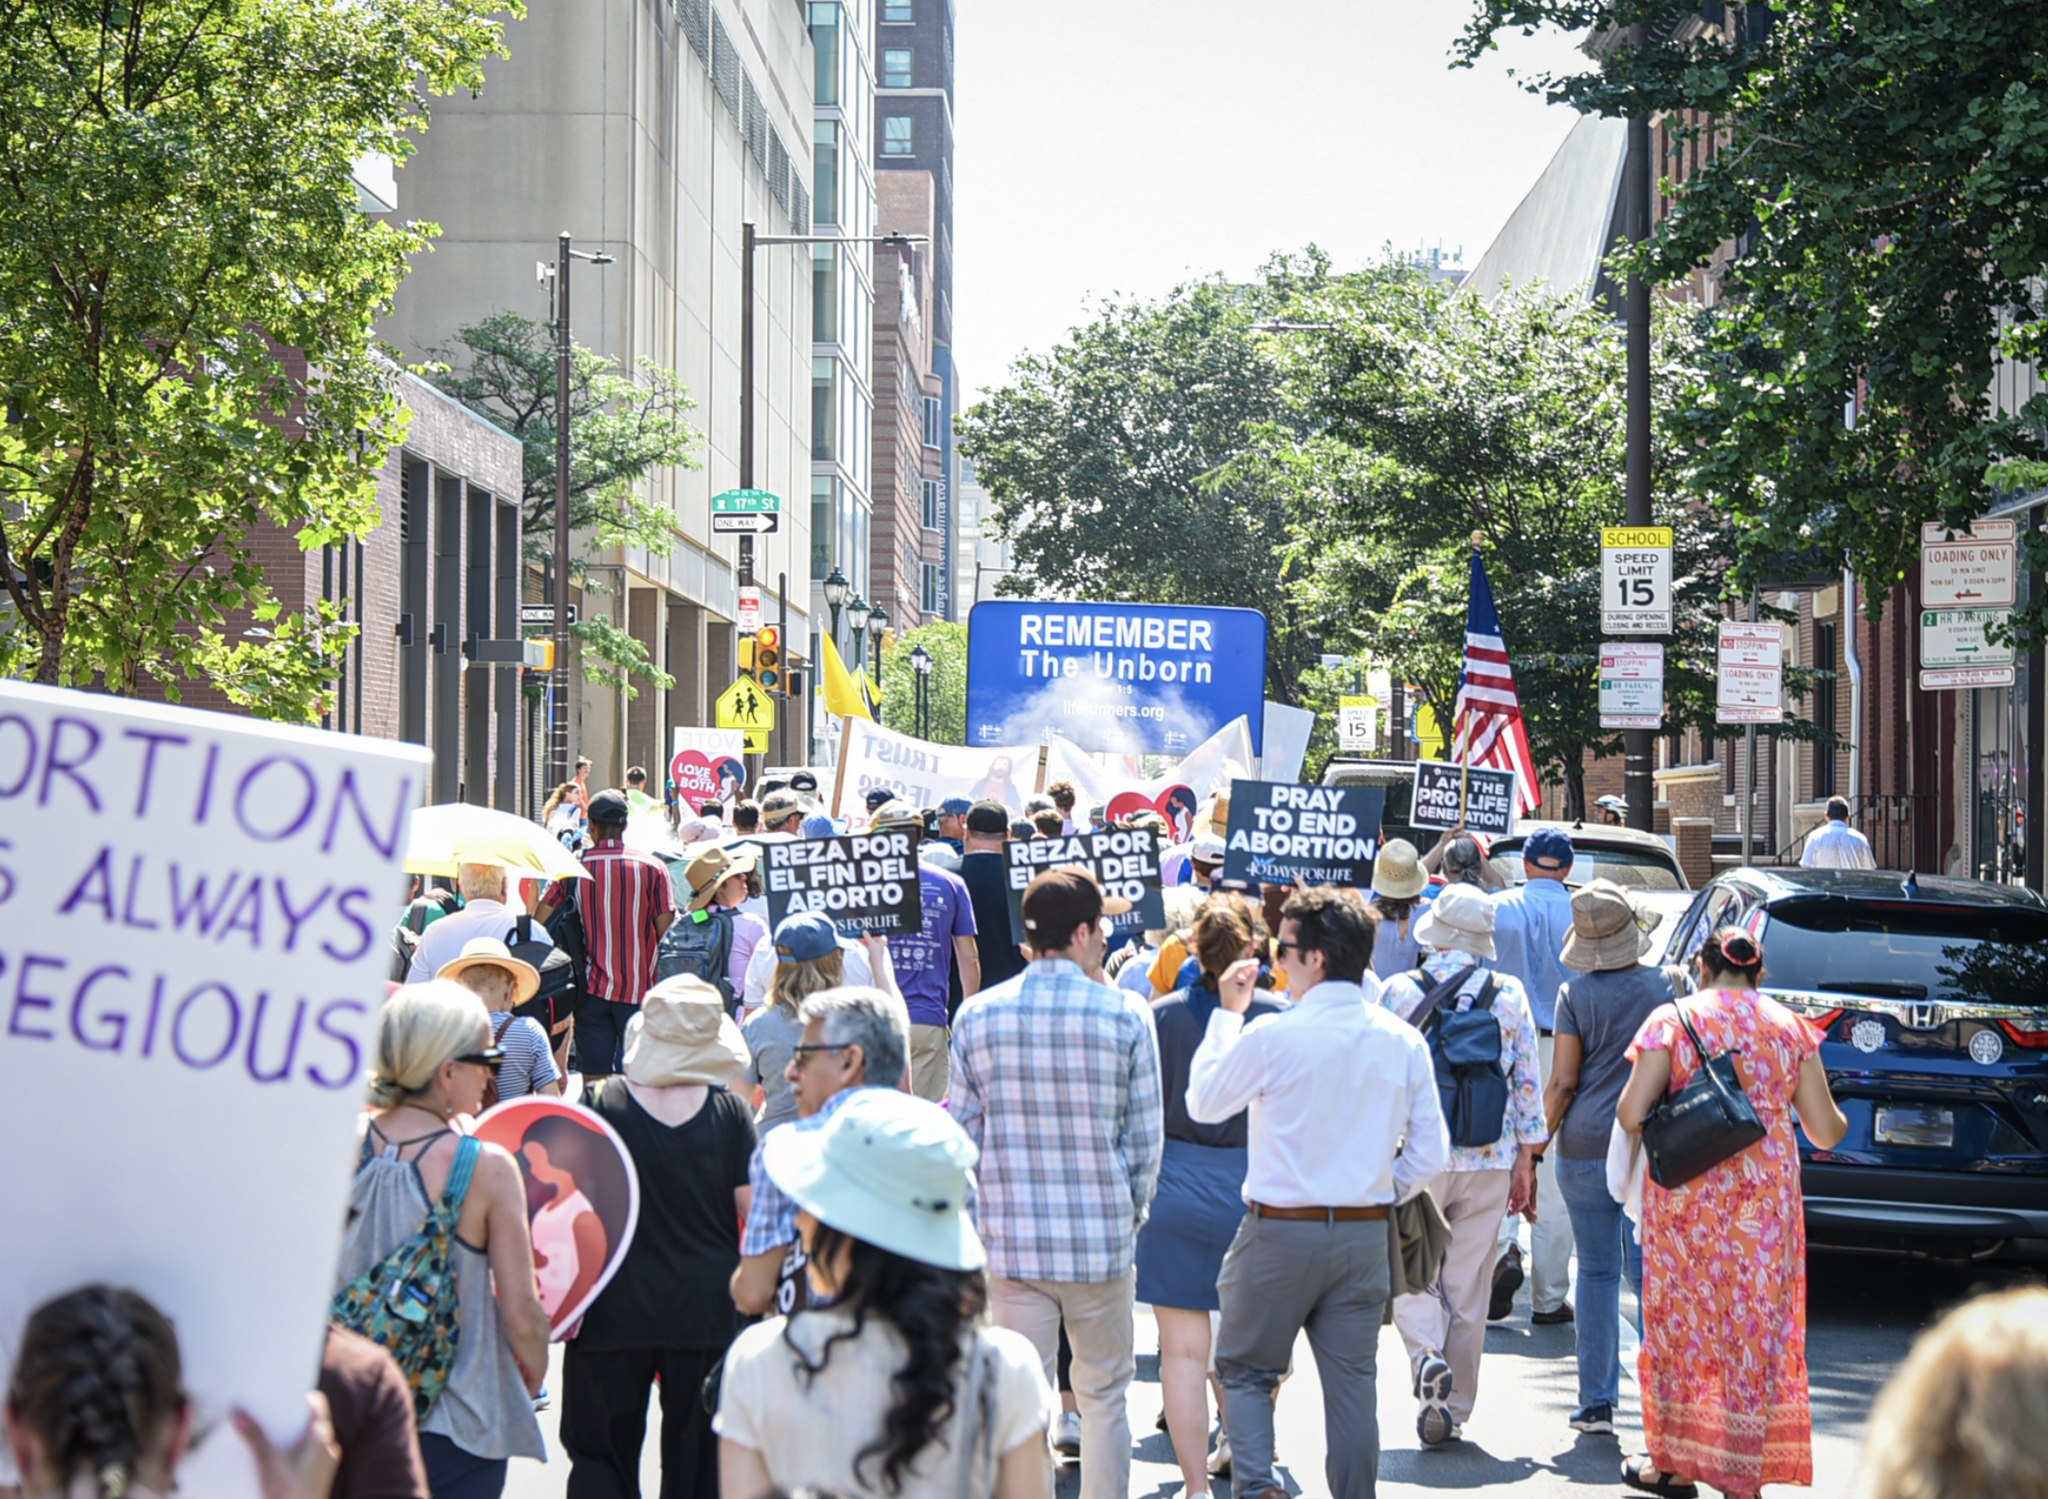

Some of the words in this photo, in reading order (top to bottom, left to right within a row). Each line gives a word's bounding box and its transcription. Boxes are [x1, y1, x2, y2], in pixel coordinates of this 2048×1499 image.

[734, 497, 757, 510] 17th
[761, 497, 775, 510] St
[717, 519, 734, 527] ONE
[738, 519, 755, 527] WAY
[1607, 532, 1666, 545] SCHOOL
[1615, 554, 1659, 564] SPEED
[1928, 550, 1975, 563] LOADING
[1980, 548, 2007, 561] ONLY
[1618, 566, 1654, 575] LIMIT
[1618, 579, 1655, 606] 15
[1607, 613, 1633, 621] DURING
[1636, 613, 1666, 621] OPENING
[1926, 613, 1933, 625] 2
[1939, 612, 1953, 624] HR
[1957, 610, 2000, 623] PARKING
[1019, 614, 1213, 651] REMEMBER
[1736, 641, 1768, 651] STOPPING
[1020, 650, 1079, 678] The
[1093, 651, 1212, 684] Unborn
[1725, 669, 1754, 679] LOADING
[1757, 671, 1774, 681] ONLY
[1117, 684, 1133, 695] 1:5
[1349, 723, 1367, 737] 15
[678, 762, 711, 778] LOVE
[680, 776, 716, 793] BOTH
[1423, 774, 1429, 787] I
[1436, 776, 1462, 790] AM
[1471, 780, 1505, 795] THE
[1270, 785, 1346, 812] PRAY
[1253, 807, 1293, 832] TO
[1298, 811, 1357, 837] END
[769, 839, 848, 867] REZA
[851, 833, 910, 859] POR
[1009, 837, 1087, 866] REZA
[1091, 830, 1151, 857] POR
[1228, 829, 1376, 861] ABORTION
[769, 868, 805, 892] EL
[809, 862, 857, 888] FIN
[861, 857, 915, 883] DEL
[1102, 854, 1158, 880] DEL
[1245, 861, 1266, 877] 40
[1300, 866, 1325, 881] FOR
[1326, 867, 1353, 882] LIFE
[58, 845, 374, 962] ALWAYS
[786, 882, 904, 914] ABORTO
[847, 915, 874, 931] FOR
[874, 914, 902, 930] LIFE
[0, 950, 368, 1089] EGIOUS
